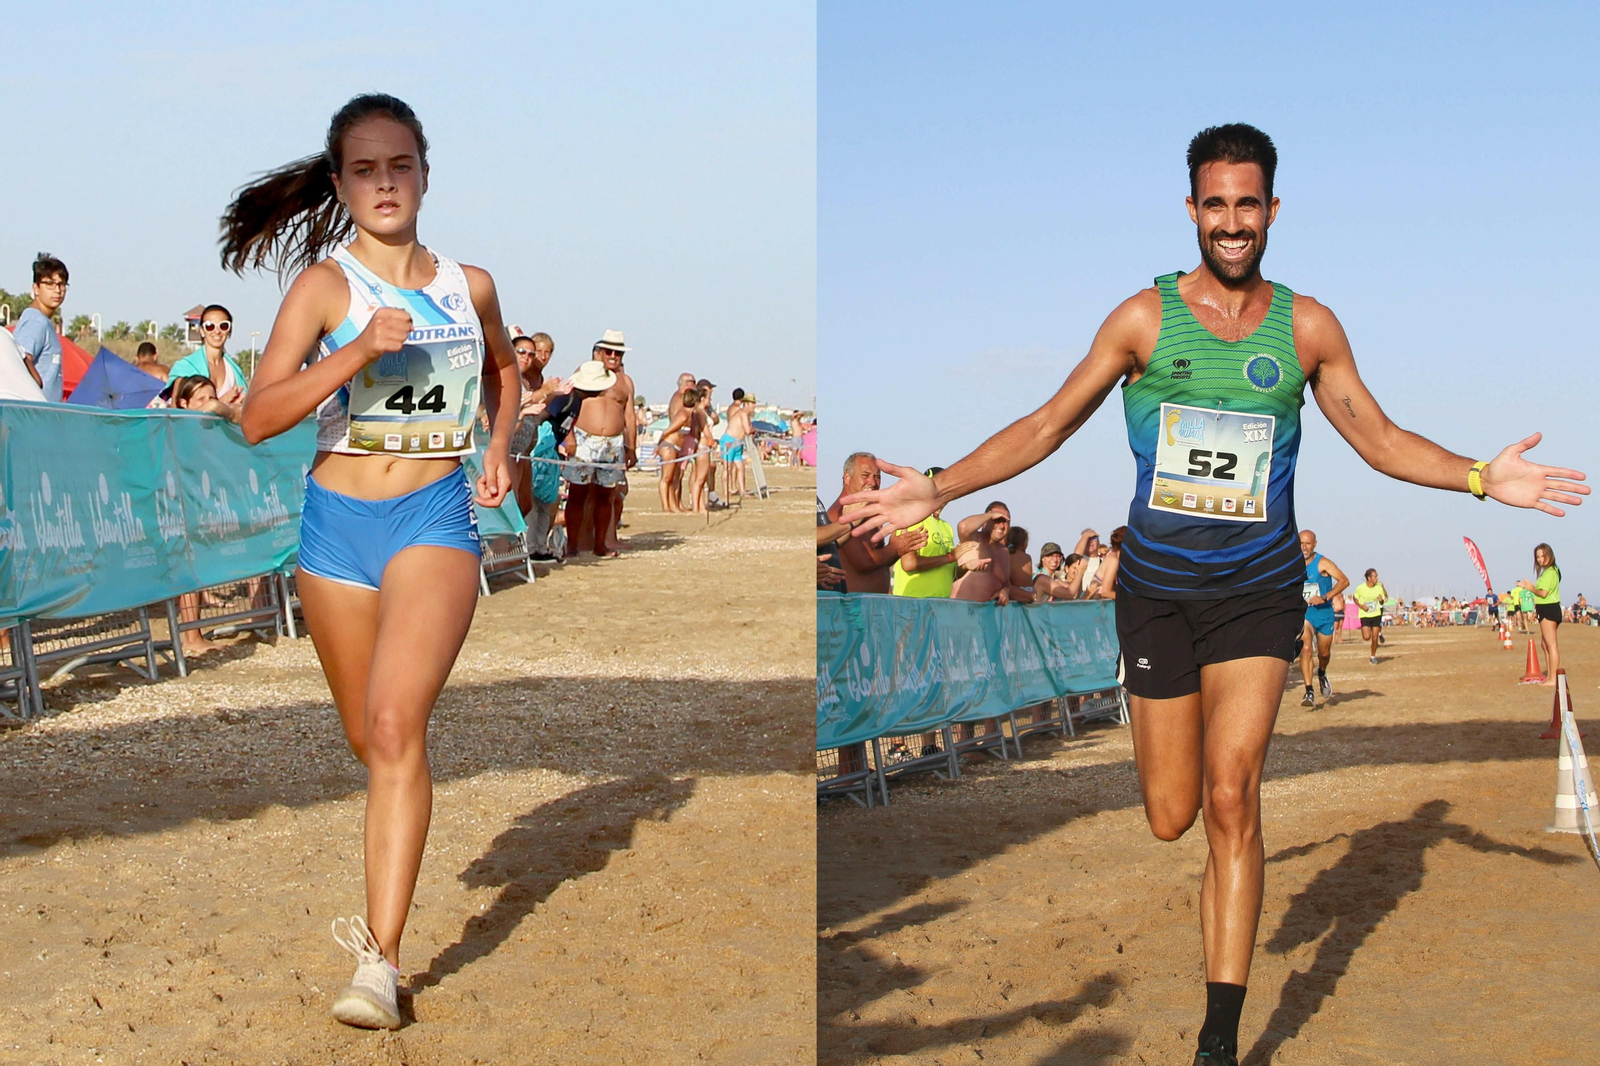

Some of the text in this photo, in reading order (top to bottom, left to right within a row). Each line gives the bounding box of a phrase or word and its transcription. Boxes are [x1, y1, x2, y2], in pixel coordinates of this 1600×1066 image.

[446, 344, 473, 357] Edición
[449, 350, 475, 371] XIX
[385, 384, 447, 414] 44
[1180, 418, 1204, 431] MILLA
[1242, 422, 1268, 431] Edición
[1243, 429, 1268, 443] XIX
[1187, 448, 1238, 480] 52
